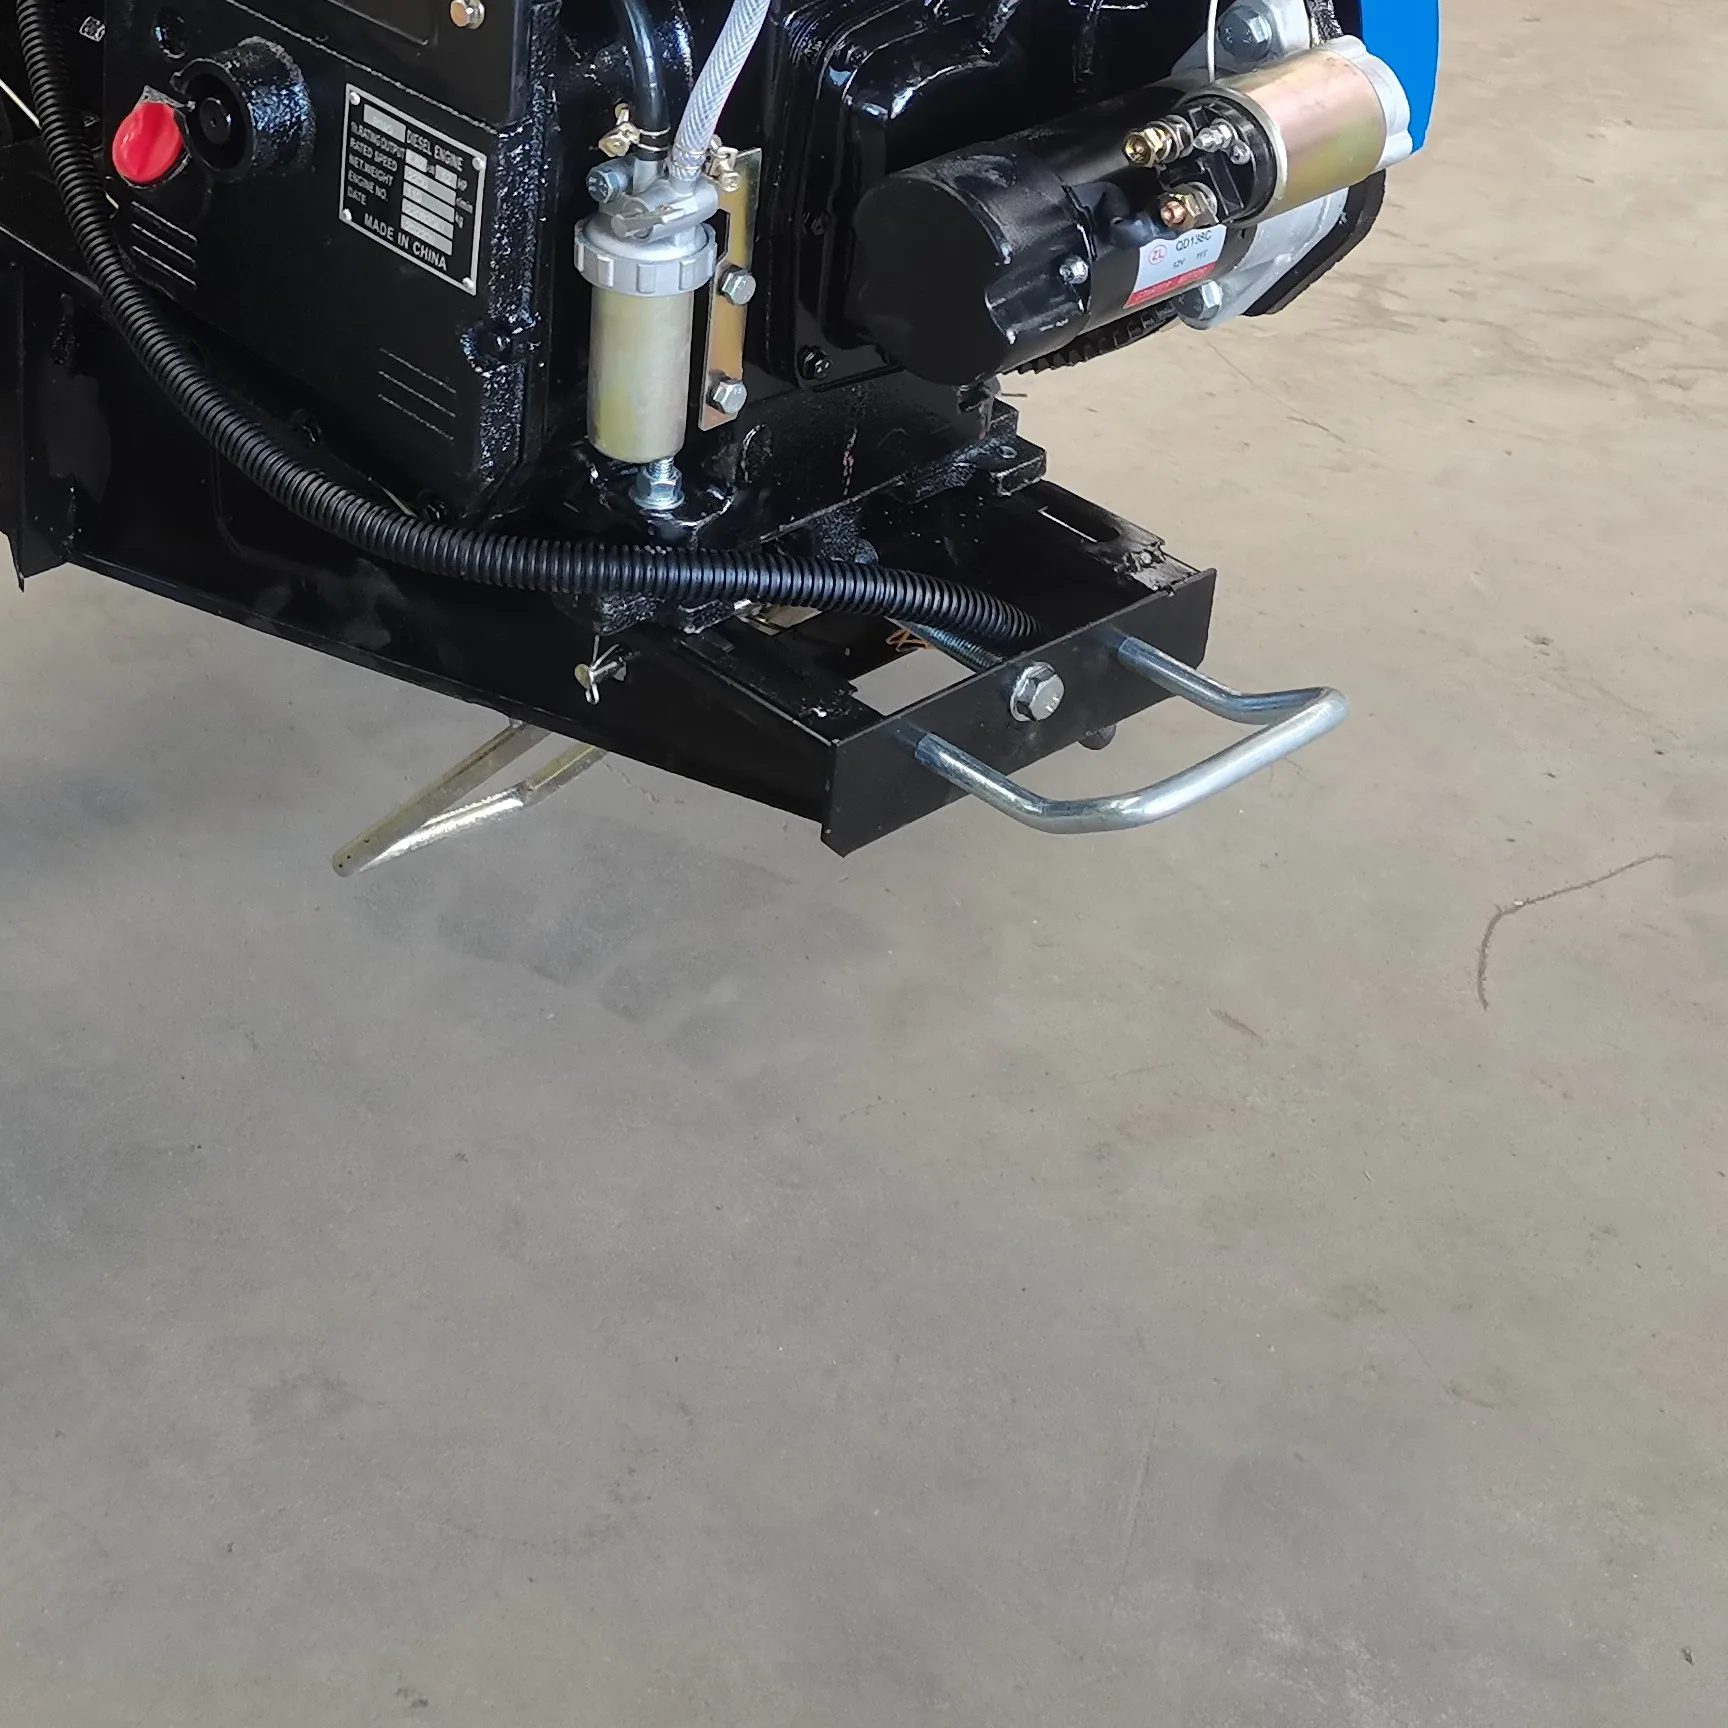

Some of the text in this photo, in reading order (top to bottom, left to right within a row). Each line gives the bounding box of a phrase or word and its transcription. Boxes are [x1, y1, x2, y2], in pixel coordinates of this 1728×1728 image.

[406, 129, 432, 156] DIESEL
[434, 144, 464, 173] ENGINE
[364, 213, 394, 239] MADE
[398, 231, 410, 250] IN
[412, 241, 447, 271] CHINA
